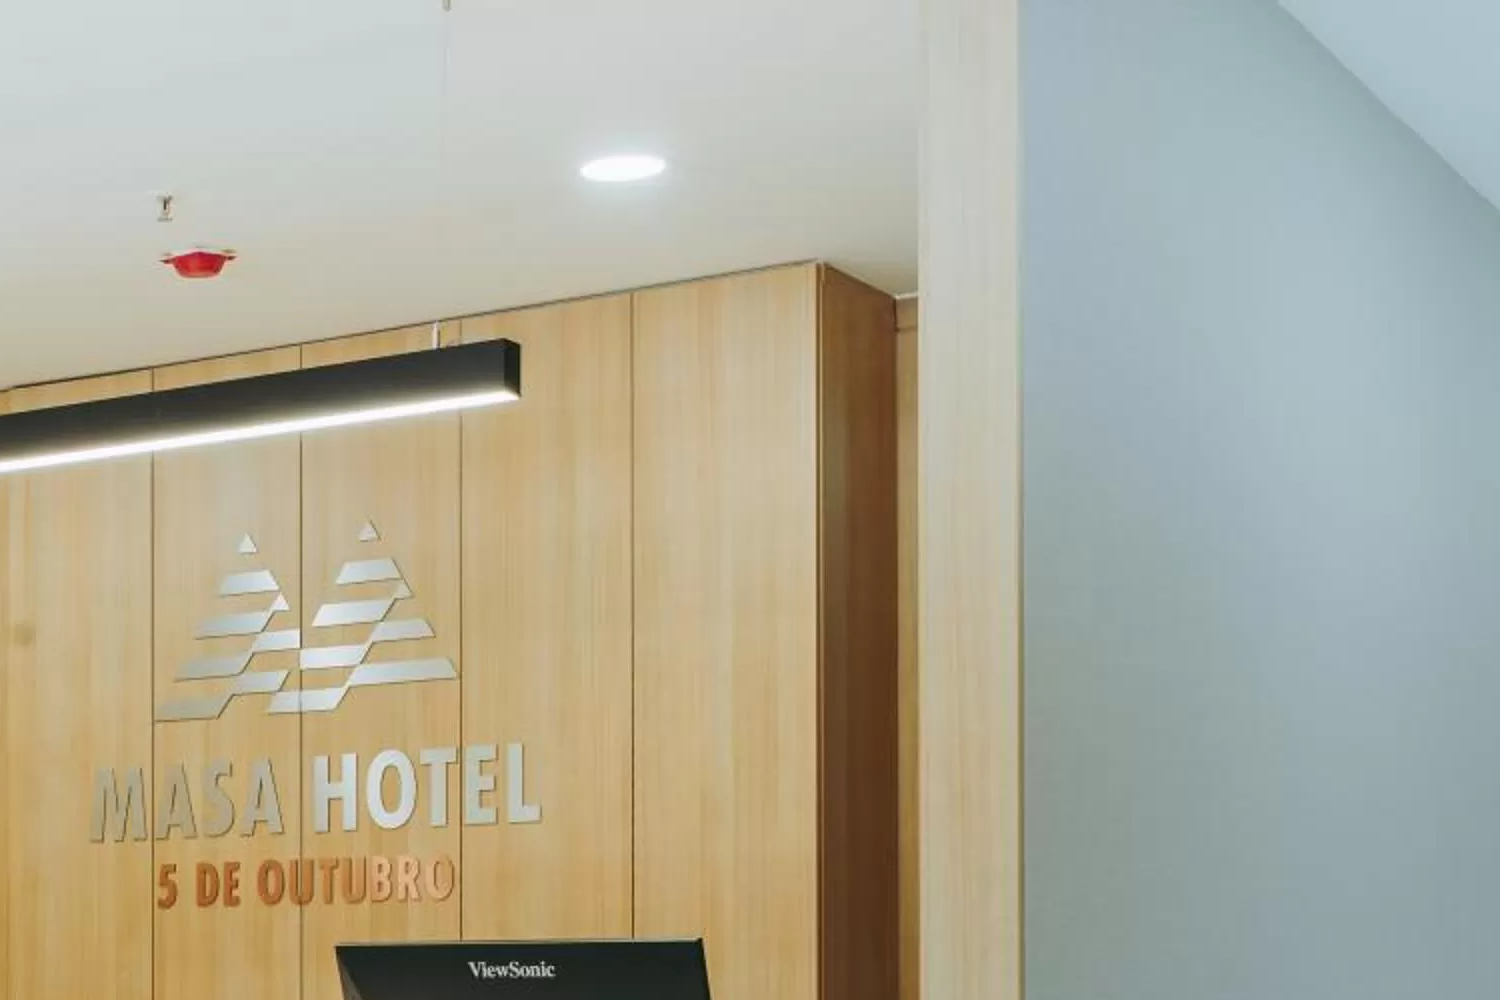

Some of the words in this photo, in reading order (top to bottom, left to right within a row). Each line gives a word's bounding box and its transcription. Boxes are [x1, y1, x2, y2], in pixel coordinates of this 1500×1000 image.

[90, 757, 285, 843] MASA
[313, 742, 542, 833] HOTEL
[157, 863, 178, 910] 5
[194, 860, 242, 908] DE
[256, 853, 456, 907] OUTUBRO
[467, 960, 557, 978] ViewSonic
